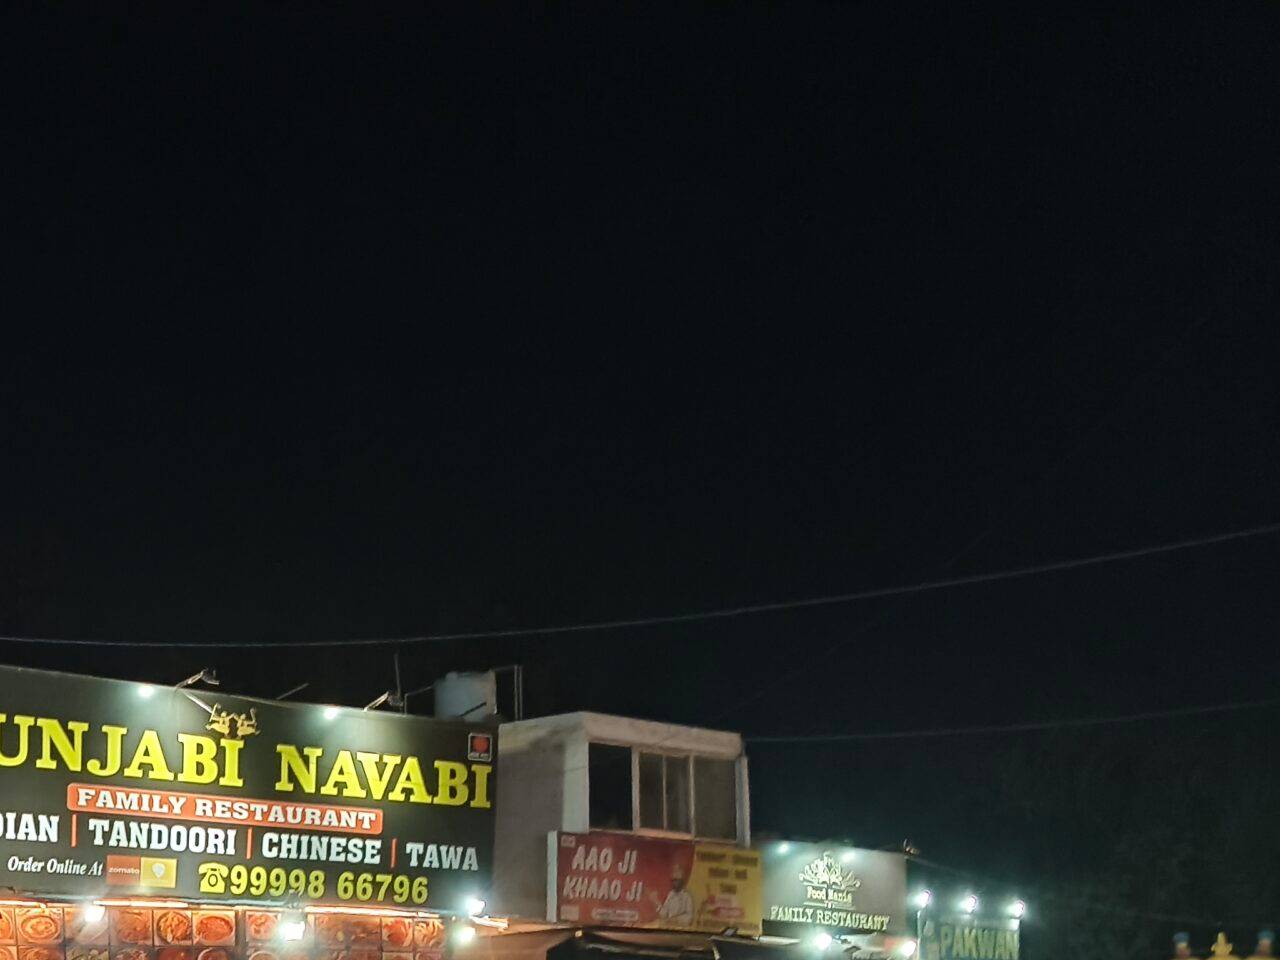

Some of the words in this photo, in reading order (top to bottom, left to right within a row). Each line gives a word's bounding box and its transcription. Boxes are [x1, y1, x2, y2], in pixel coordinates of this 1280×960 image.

[275, 744, 492, 808] NAVABI
[77, 788, 187, 815] FAMILY
[195, 798, 376, 830] RESTAURANT
[88, 818, 237, 855] TANDOORI
[262, 832, 382, 865] CHINESE
[406, 842, 479, 871] TAWA
[572, 844, 613, 873] AAO
[618, 849, 638, 875] JI
[7, 855, 45, 873] Order
[47, 858, 86, 875] Online
[88, 861, 104, 876] At
[109, 866, 140, 875] zomato
[230, 864, 326, 899] 99998
[337, 871, 429, 904] 66796
[563, 875, 621, 901] KHAAO
[627, 880, 644, 902] JI
[807, 886, 826, 901] Food
[770, 906, 813, 924] FAMILY
[816, 909, 890, 931] RESTAURANT
[940, 926, 1019, 960] PAKWAN
